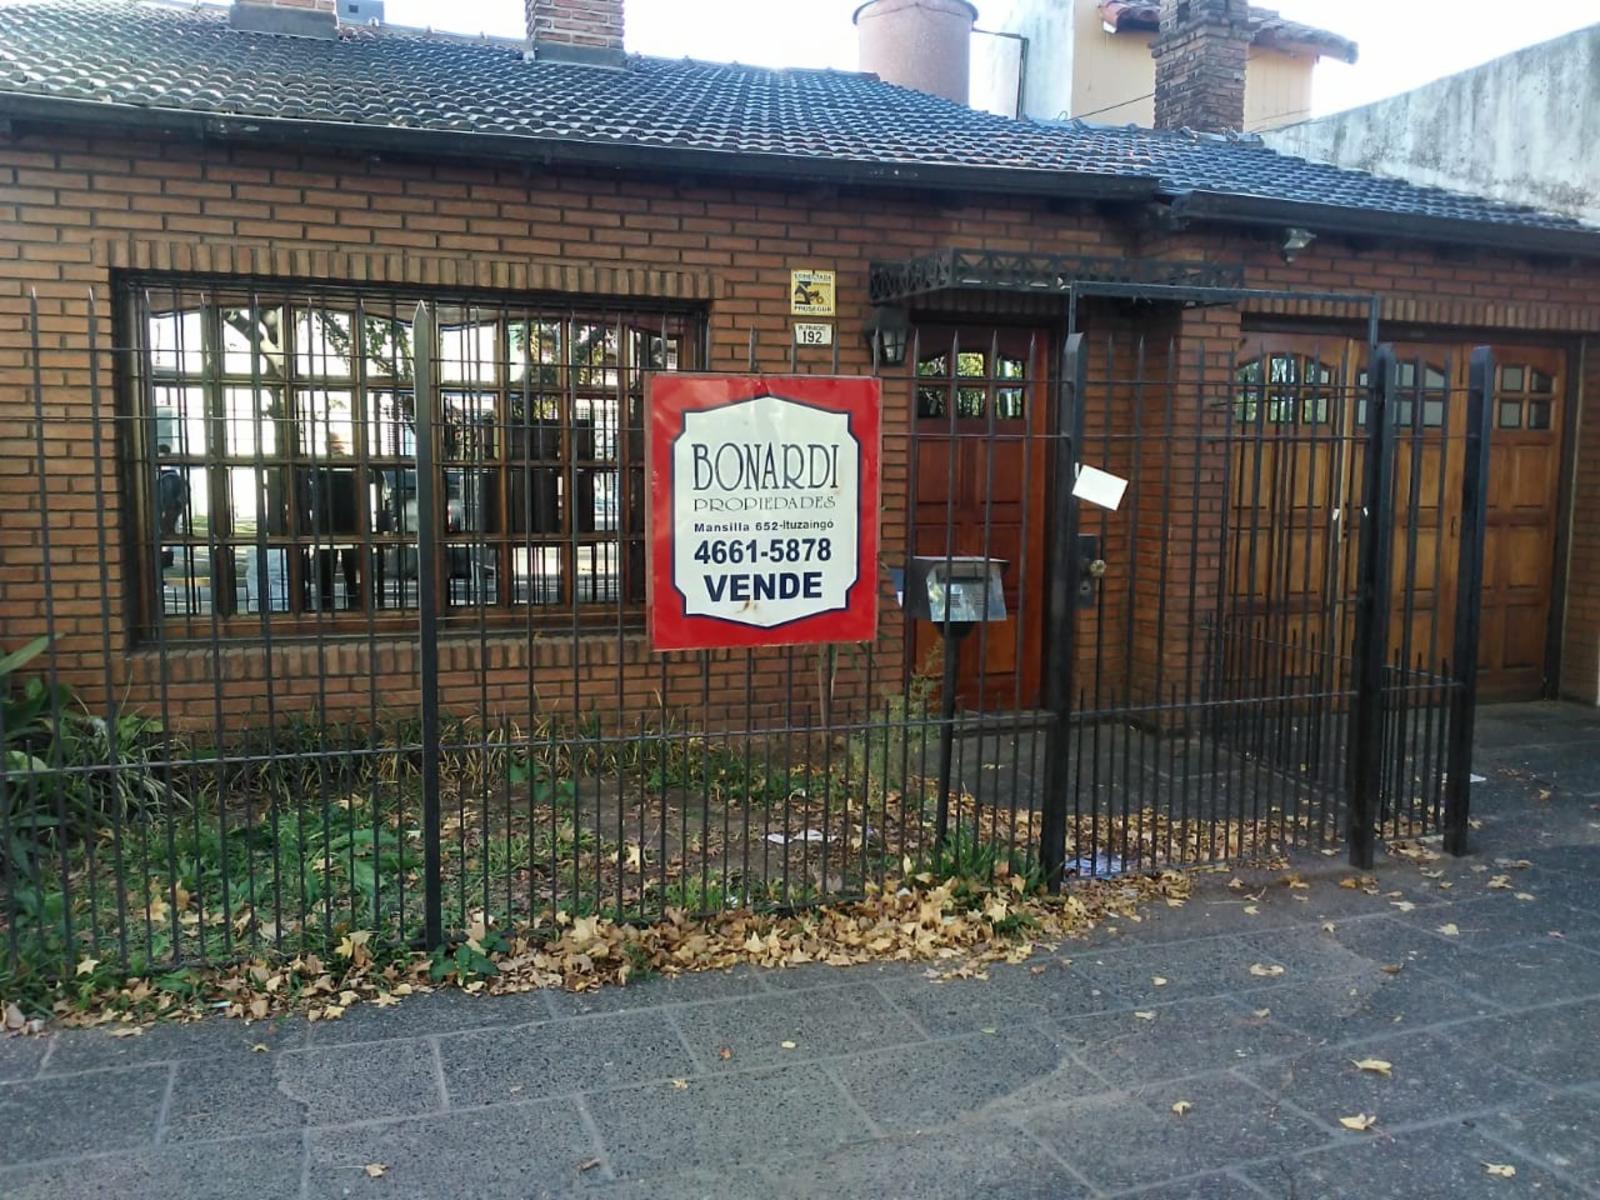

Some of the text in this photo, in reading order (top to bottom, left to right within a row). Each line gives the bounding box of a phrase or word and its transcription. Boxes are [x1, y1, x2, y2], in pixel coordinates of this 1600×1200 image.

[803, 330, 822, 343] 192
[691, 442, 839, 491] BONARDI
[694, 495, 836, 512] PROPIEDADES
[694, 522, 750, 533] Mansilla
[694, 538, 832, 564] 4661-5878
[704, 572, 823, 602] VENDE
